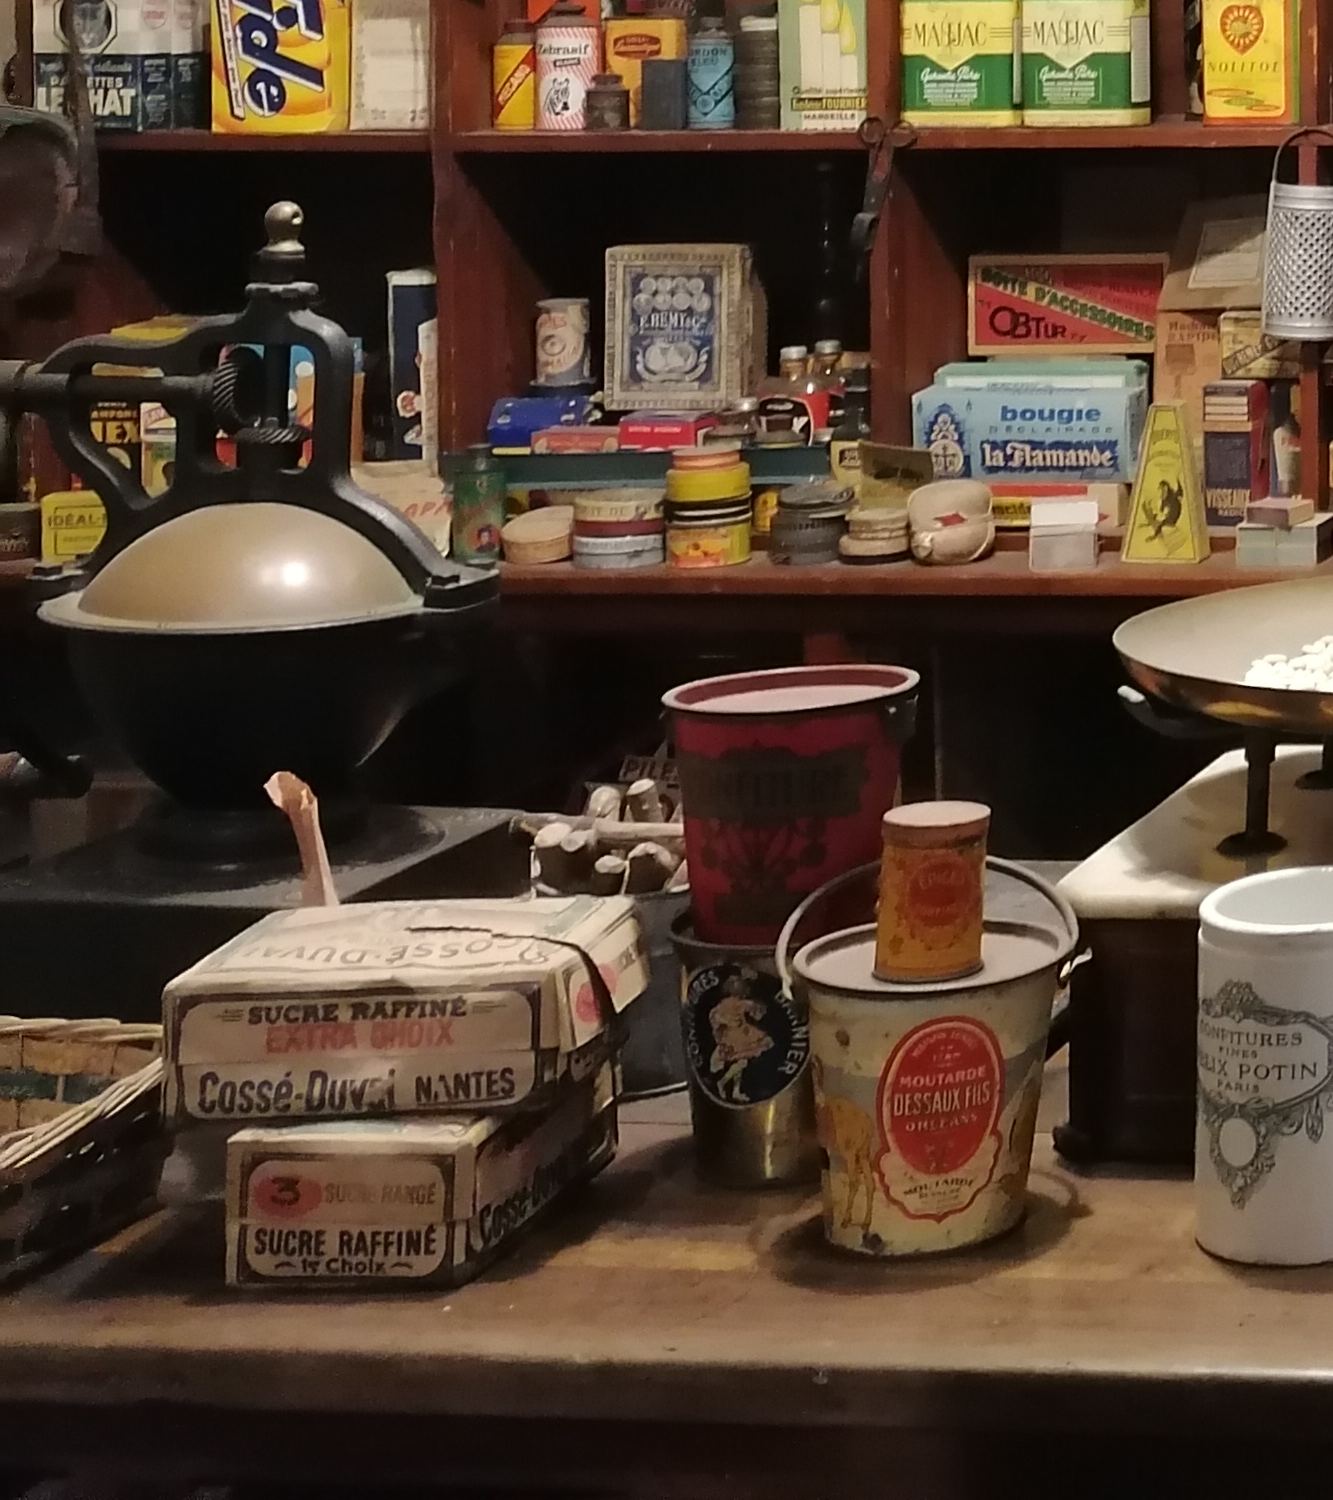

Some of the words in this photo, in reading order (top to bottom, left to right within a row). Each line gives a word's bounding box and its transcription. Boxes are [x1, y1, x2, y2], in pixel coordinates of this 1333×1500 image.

[1000, 405, 1101, 425] bougie
[1007, 442, 1115, 468] Flamande
[248, 1002, 339, 1025] SUCRE
[349, 998, 467, 1023] RAFFINÉ
[264, 1022, 358, 1054] EXTRA
[370, 1020, 456, 1050] CHOIX
[1218, 1046, 1258, 1059] FINES
[899, 1064, 986, 1088] MOUTARDE
[1239, 1062, 1318, 1081] POTIN
[414, 1066, 516, 1104] NANTES
[1217, 1079, 1260, 1094] PARIS
[893, 1089, 961, 1117] DESSAUX
[269, 1176, 301, 1205] 3
[254, 1230, 326, 1258] SUCRE
[337, 1224, 437, 1257] RAFFINÉ
[325, 1257, 387, 1274] Choix
